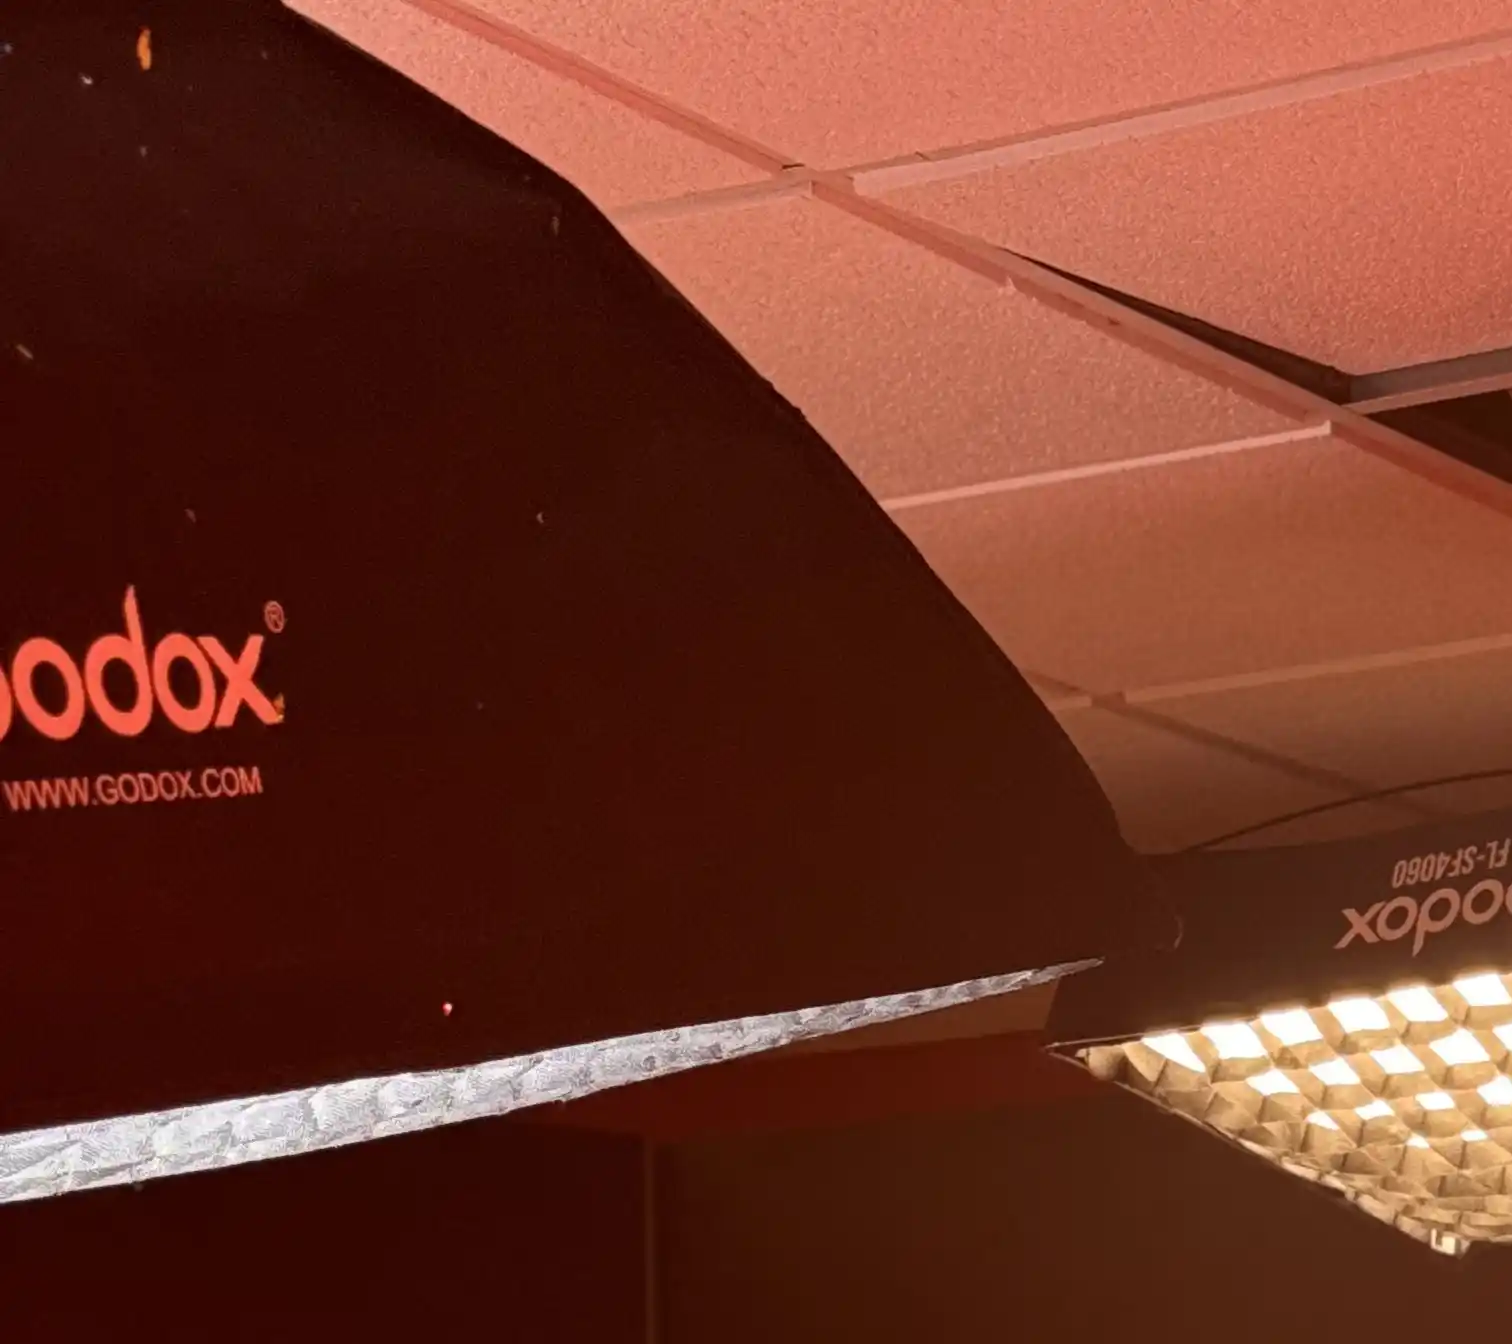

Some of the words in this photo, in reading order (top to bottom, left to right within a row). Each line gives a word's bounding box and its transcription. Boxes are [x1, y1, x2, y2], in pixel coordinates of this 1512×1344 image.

[0, 583, 283, 740] odox
[4, 766, 263, 811] WWW.GODOX.COM
[1391, 837, 1512, 889] FL-SF4060
